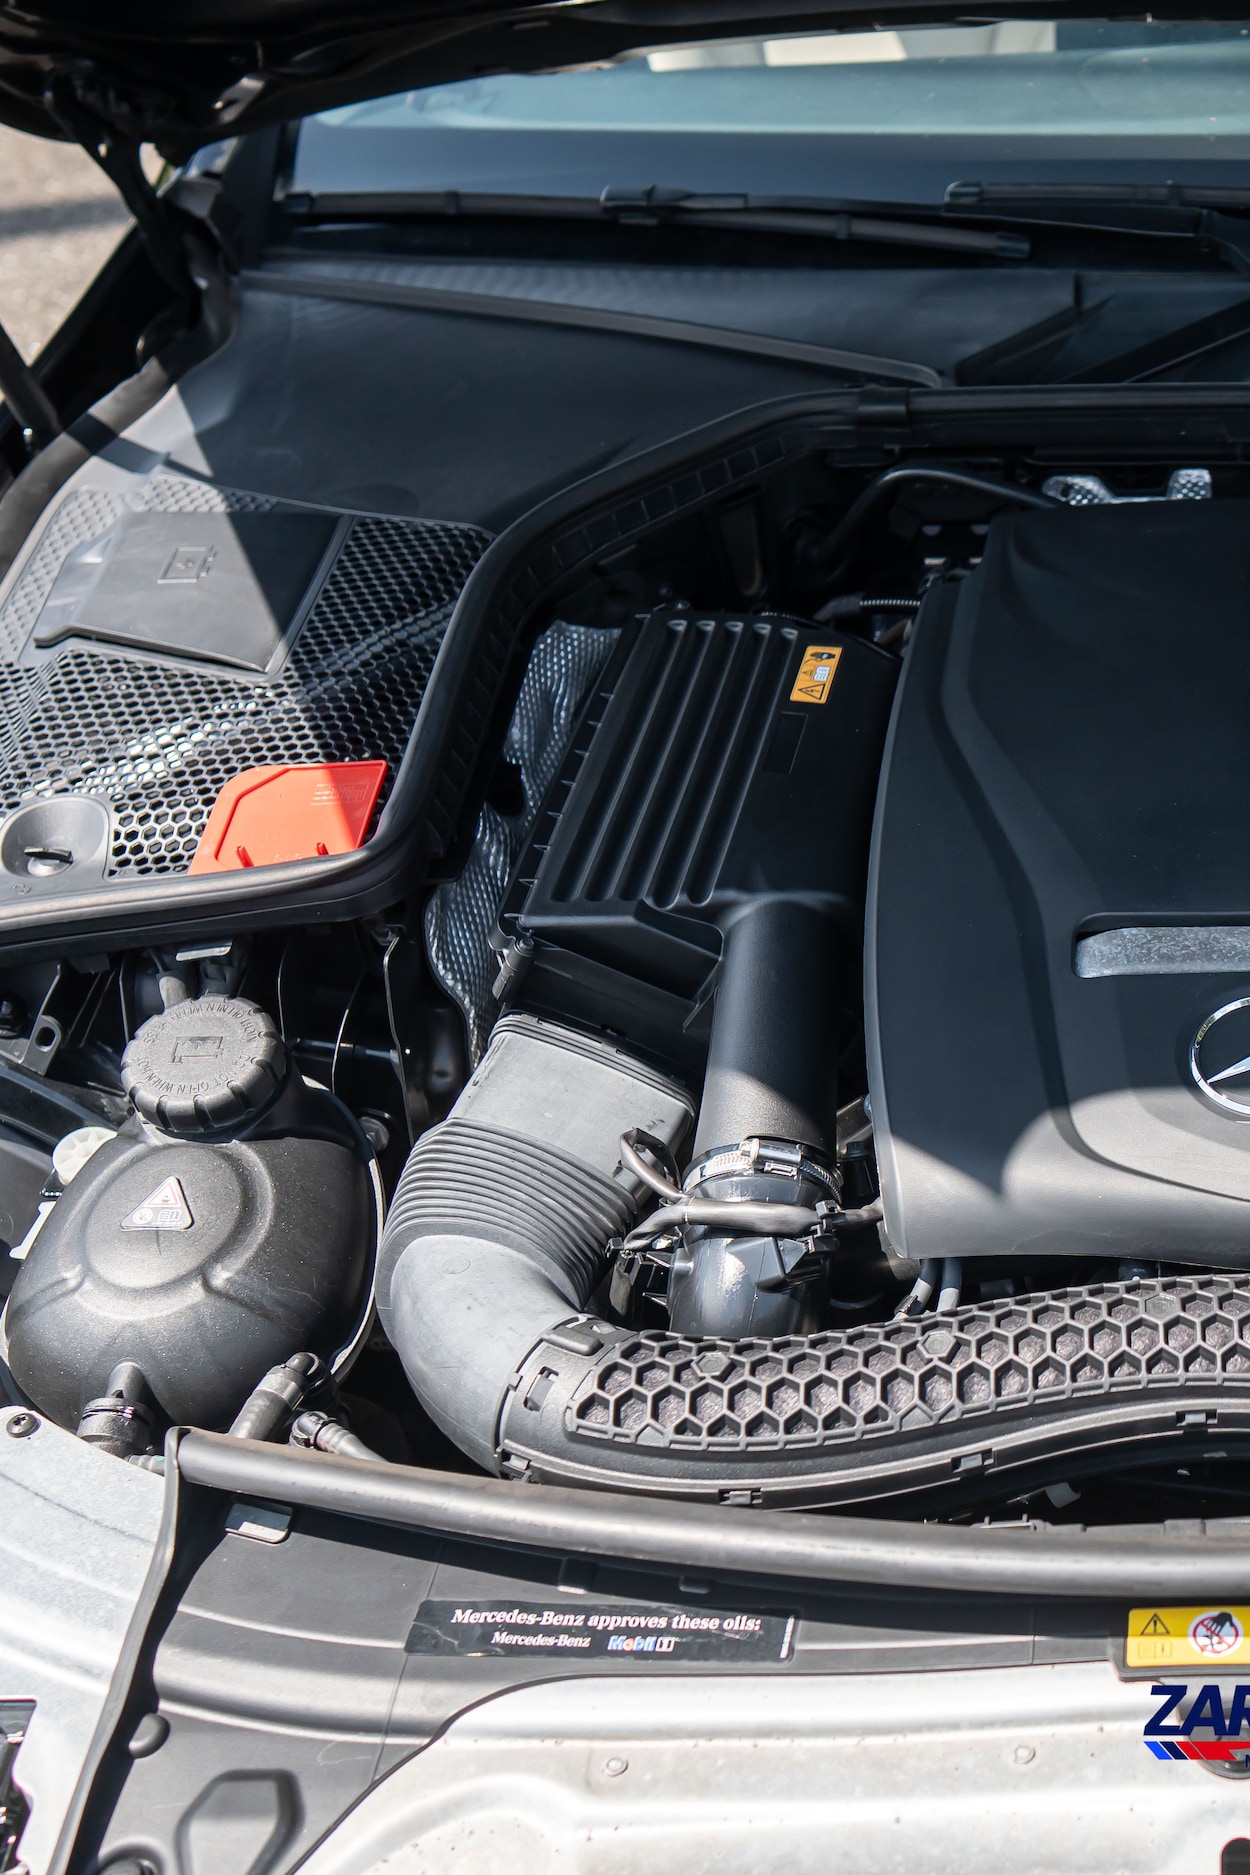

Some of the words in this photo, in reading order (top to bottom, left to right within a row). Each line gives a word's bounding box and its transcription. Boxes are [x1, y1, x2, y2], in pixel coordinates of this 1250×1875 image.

[146, 1072, 174, 1093] WHEN
[177, 1081, 210, 1095] OPEN
[451, 1608, 585, 1628] Mercedes-Benz
[587, 1613, 668, 1631] approves
[671, 1614, 720, 1631] these
[722, 1614, 762, 1632] oils:
[490, 1631, 591, 1649] Mercedes-Benz
[608, 1635, 656, 1652] Mobil
